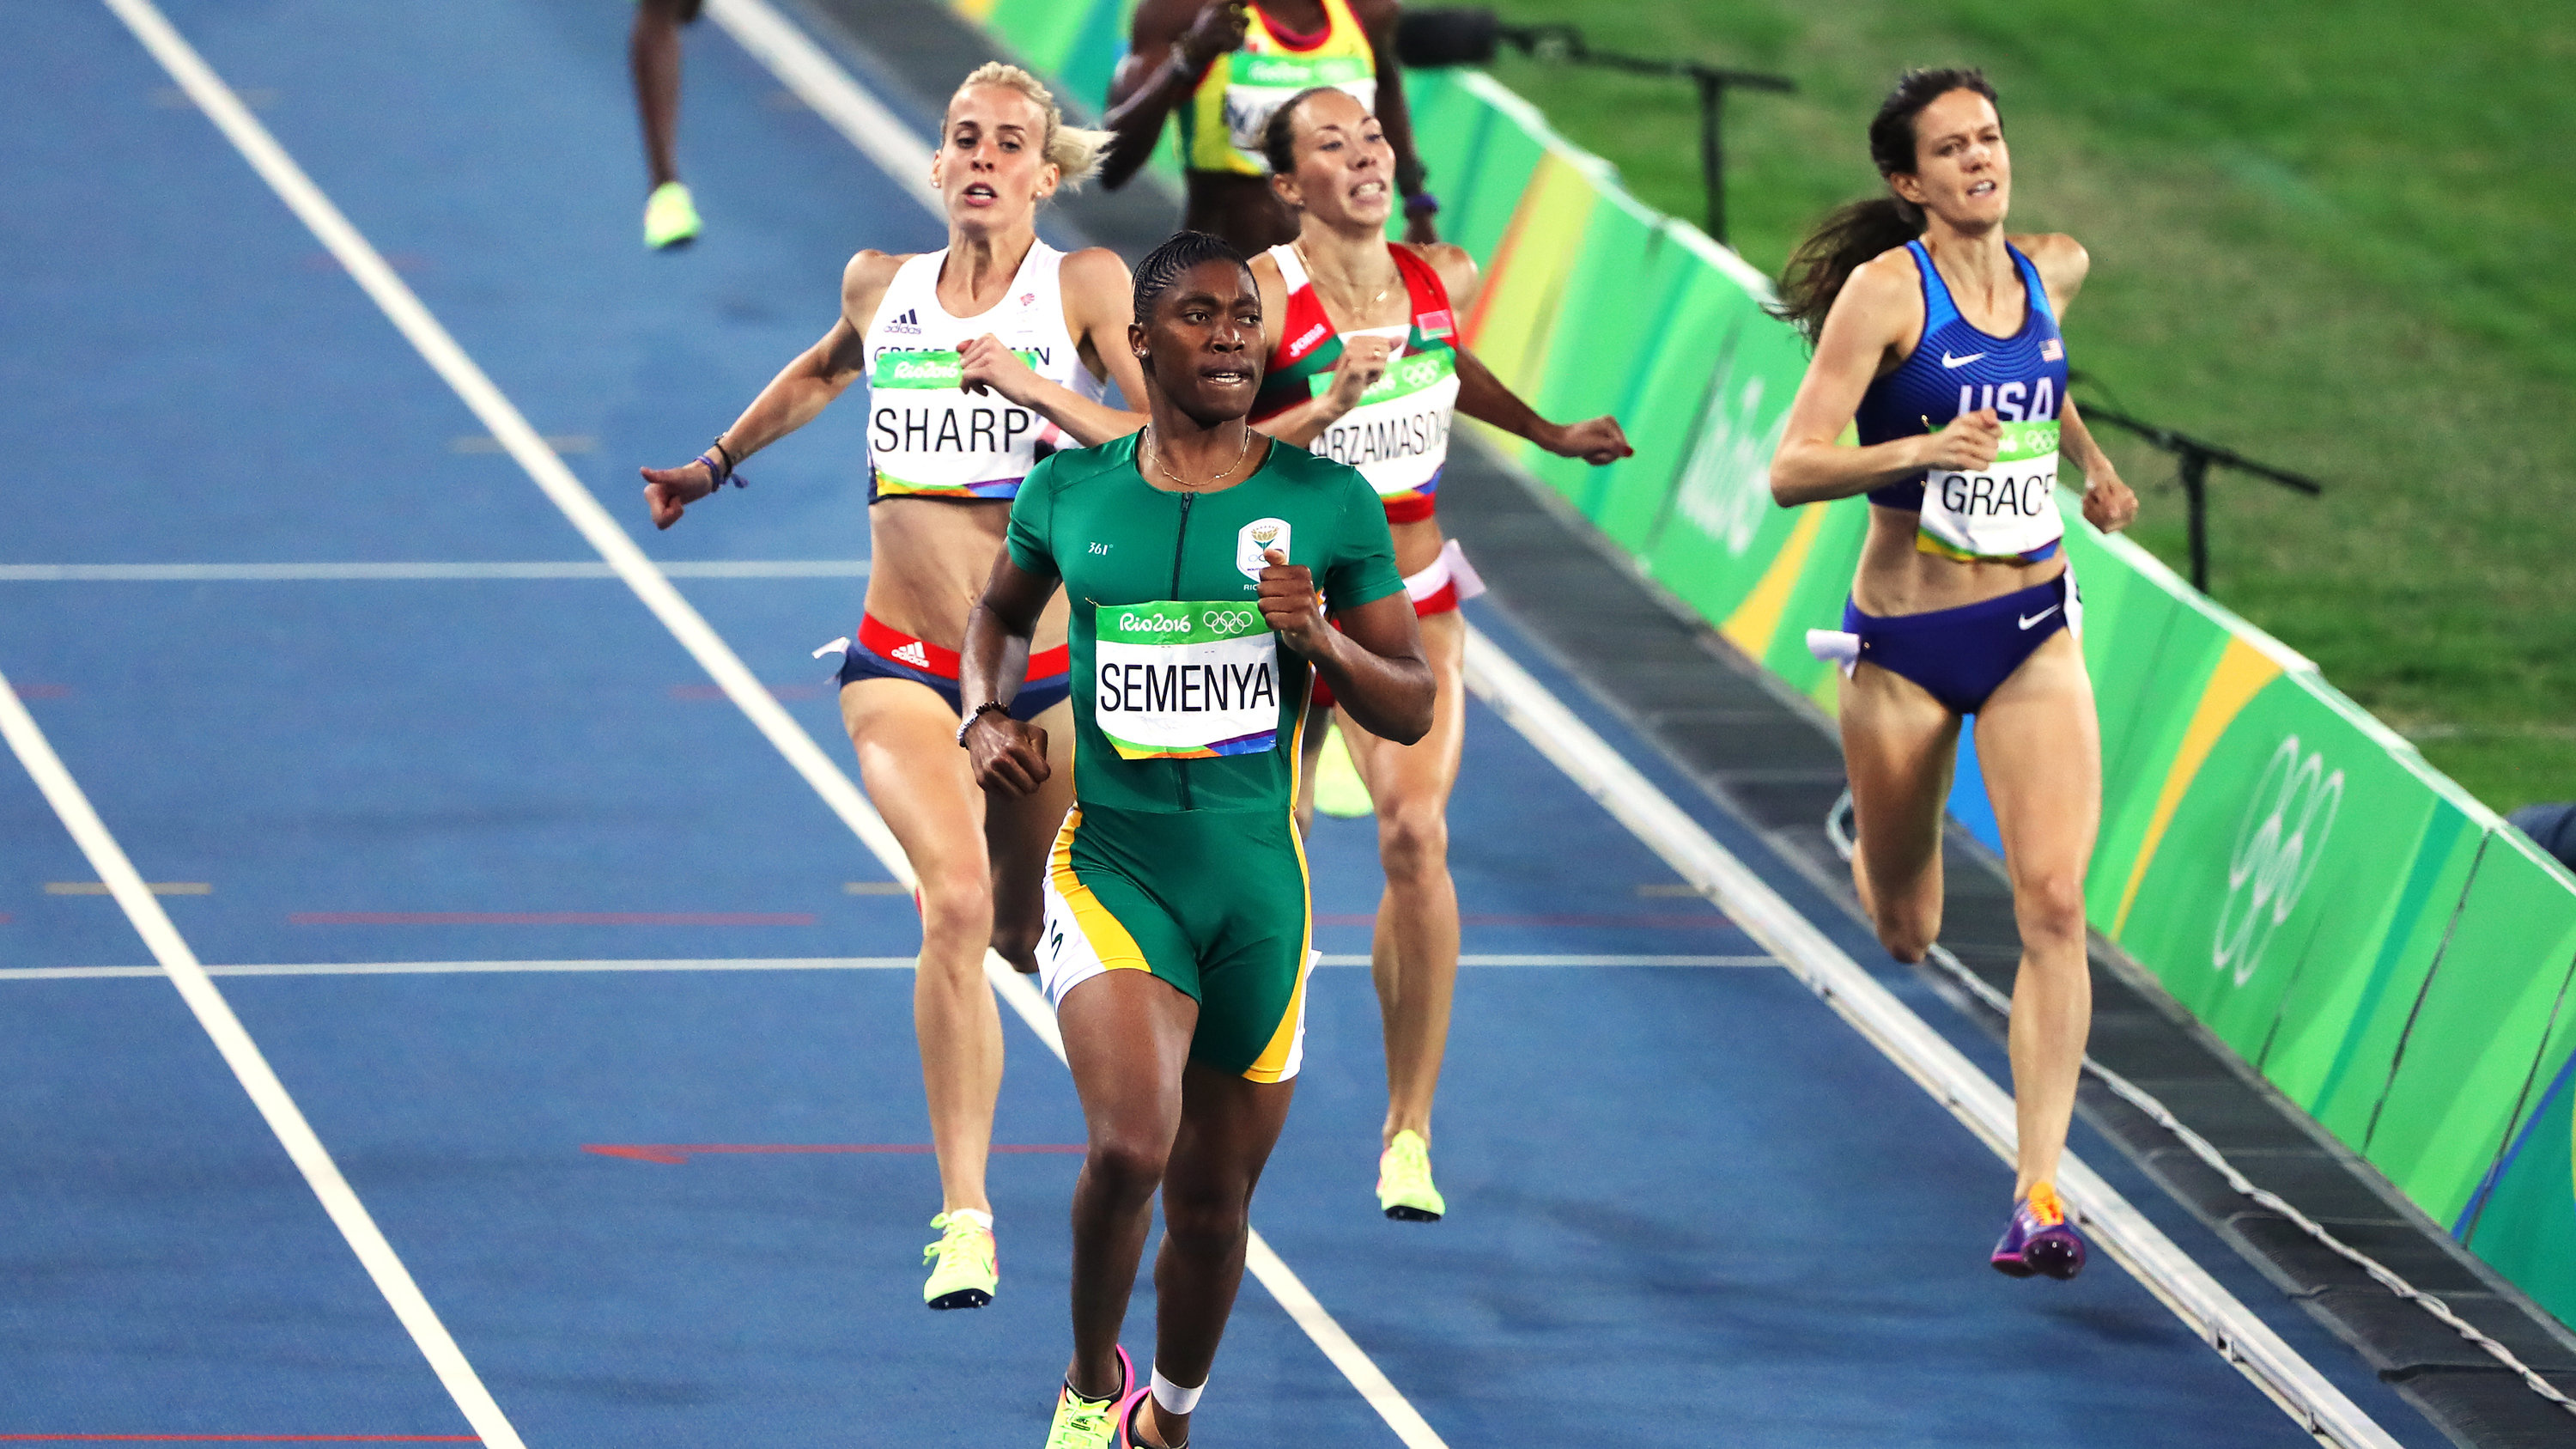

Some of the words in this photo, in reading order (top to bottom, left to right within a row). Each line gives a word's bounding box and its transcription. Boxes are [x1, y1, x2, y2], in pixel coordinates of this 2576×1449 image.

[884, 323, 921, 335] adidas
[894, 361, 959, 379] Rio2016
[1958, 376, 2055, 423] USA
[875, 408, 1030, 453] SHARP
[1120, 612, 1192, 633] Rio2016
[890, 648, 930, 668] adidas
[1100, 662, 1275, 712] SEMENYA
